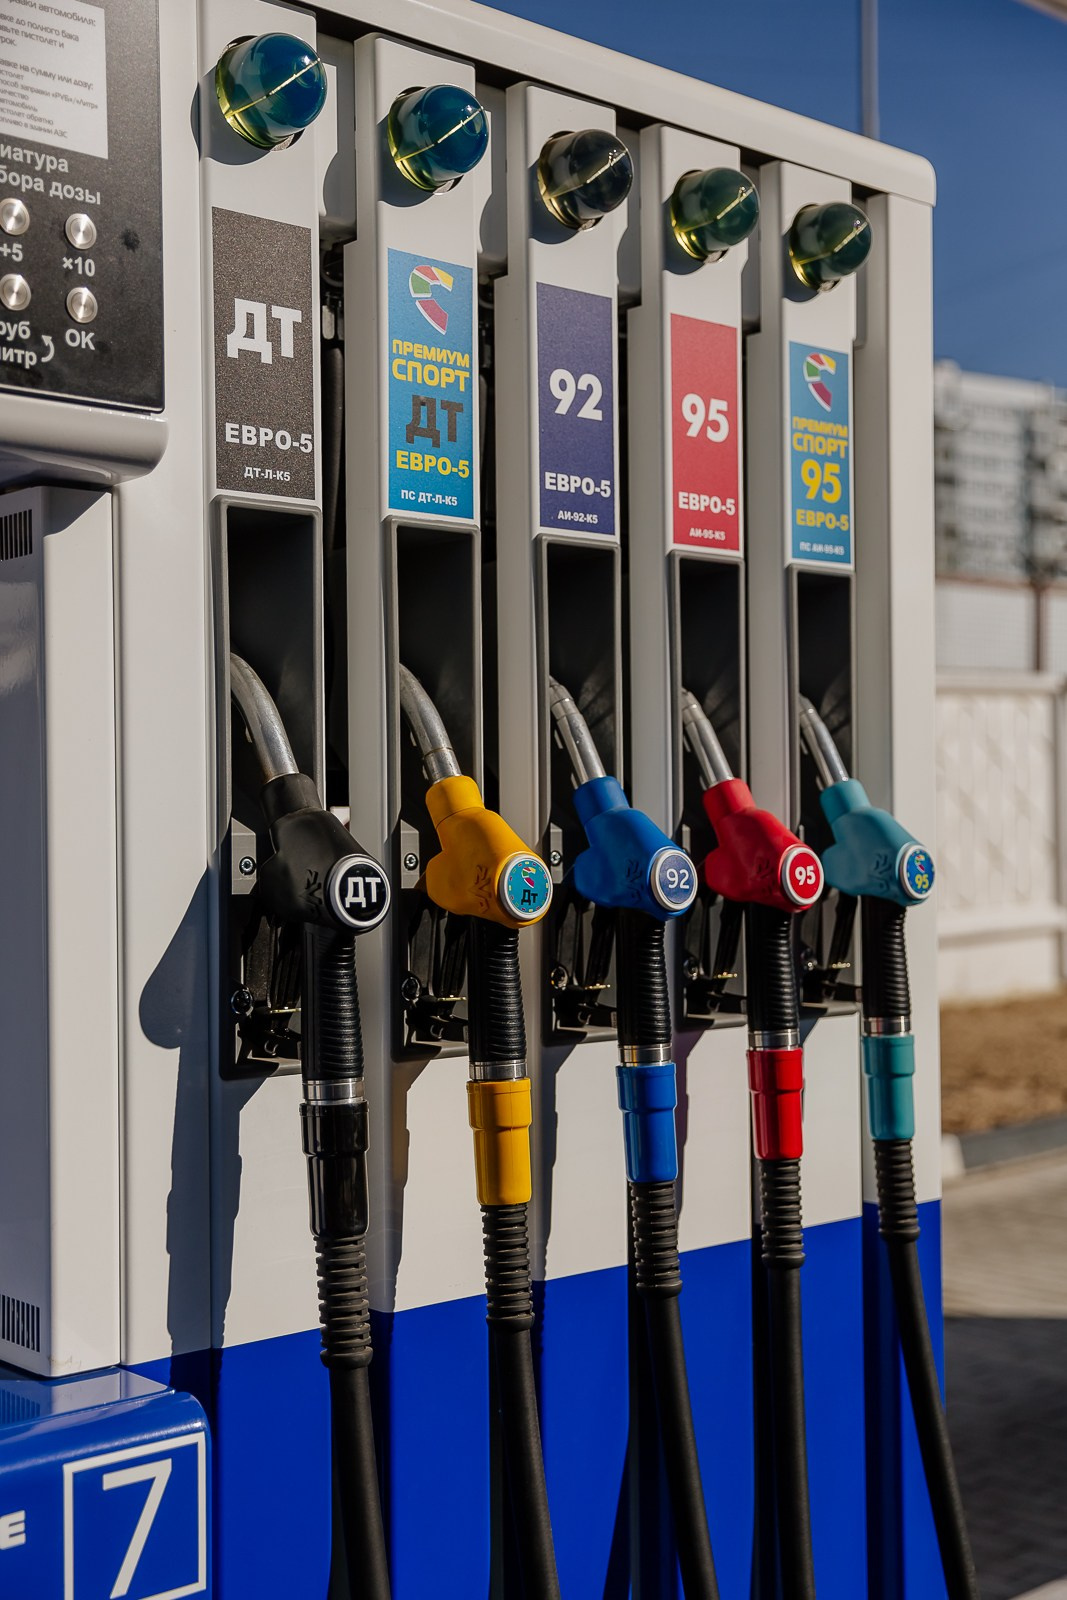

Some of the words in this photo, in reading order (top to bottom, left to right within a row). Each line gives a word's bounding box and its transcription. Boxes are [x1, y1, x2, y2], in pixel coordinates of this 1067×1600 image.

[38, 4, 96, 26] автомобиля:
[15, 18, 26, 26] до
[27, 21, 60, 36] полного
[61, 30, 80, 42] бака
[21, 30, 57, 46] пистолет
[20, 64, 30, 72] на
[31, 67, 56, 80] сумму
[57, 74, 72, 84] или
[73, 79, 94, 90] дозу:
[54, 129, 69, 138] АЗС
[0, 143, 69, 173] иатура
[49, 181, 101, 205] дозы
[65, 329, 96, 351] OK
[226, 298, 302, 364] ДТ
[392, 339, 470, 368] ПРЕМИУМ
[392, 360, 470, 392] СПОРТ
[549, 368, 603, 422] 92
[405, 394, 464, 448] ДТ
[681, 393, 730, 443] 95
[793, 416, 849, 438] ПРЕМИУМ
[225, 422, 313, 454] ЕВРО-5
[793, 433, 849, 459] СПОРТ
[244, 466, 291, 482] ДТ-Л-К5
[396, 450, 470, 479] ЕВРО-5
[544, 471, 611, 498] ЕВРО-5
[801, 459, 842, 504] 95
[401, 489, 415, 501] ПС
[418, 491, 458, 507] ДТ-Л-К5
[678, 492, 736, 516] ЕВРО-5
[557, 510, 599, 525] АИ-92-К5
[796, 508, 849, 532] ЕВРО-5
[689, 527, 725, 542] АИ-95-К5
[666, 869, 690, 890] 92
[795, 866, 816, 886] 95
[914, 873, 929, 890] 95
[345, 877, 381, 908] ДТ
[102, 1458, 172, 1599] 7
